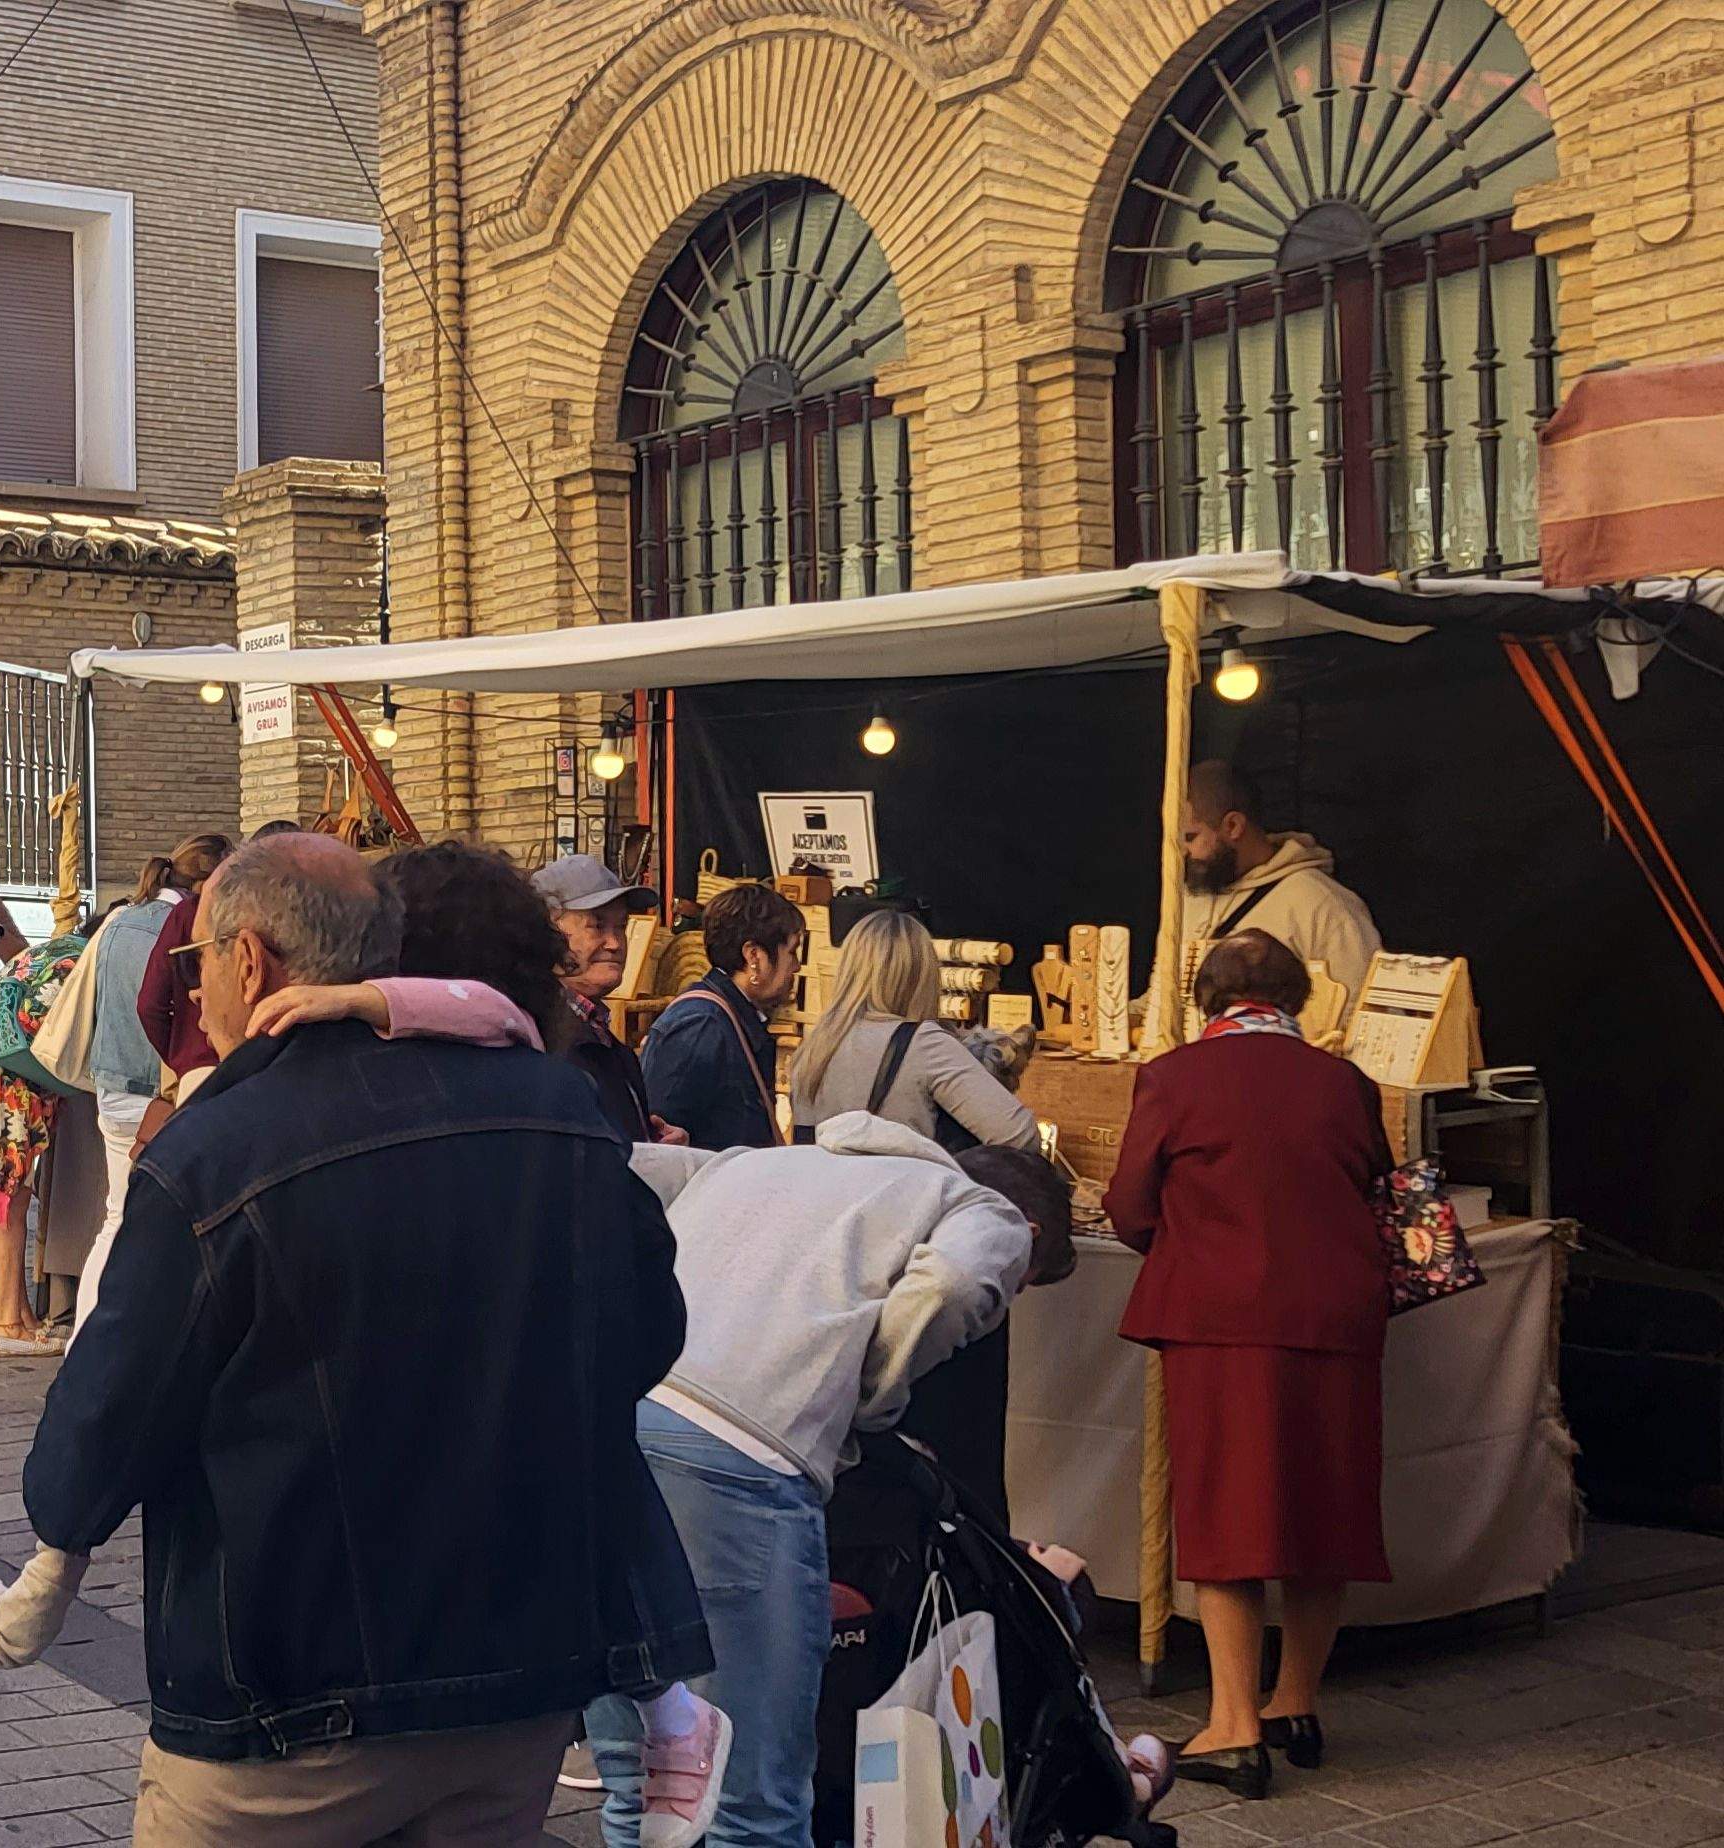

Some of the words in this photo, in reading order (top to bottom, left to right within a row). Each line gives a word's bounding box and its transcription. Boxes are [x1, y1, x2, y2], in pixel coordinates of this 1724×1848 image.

[245, 633, 286, 652] DESCARGA
[247, 696, 288, 714] AVISAMOS
[256, 717, 279, 731] GRUA
[792, 832, 848, 850] ACEPTAMOS
